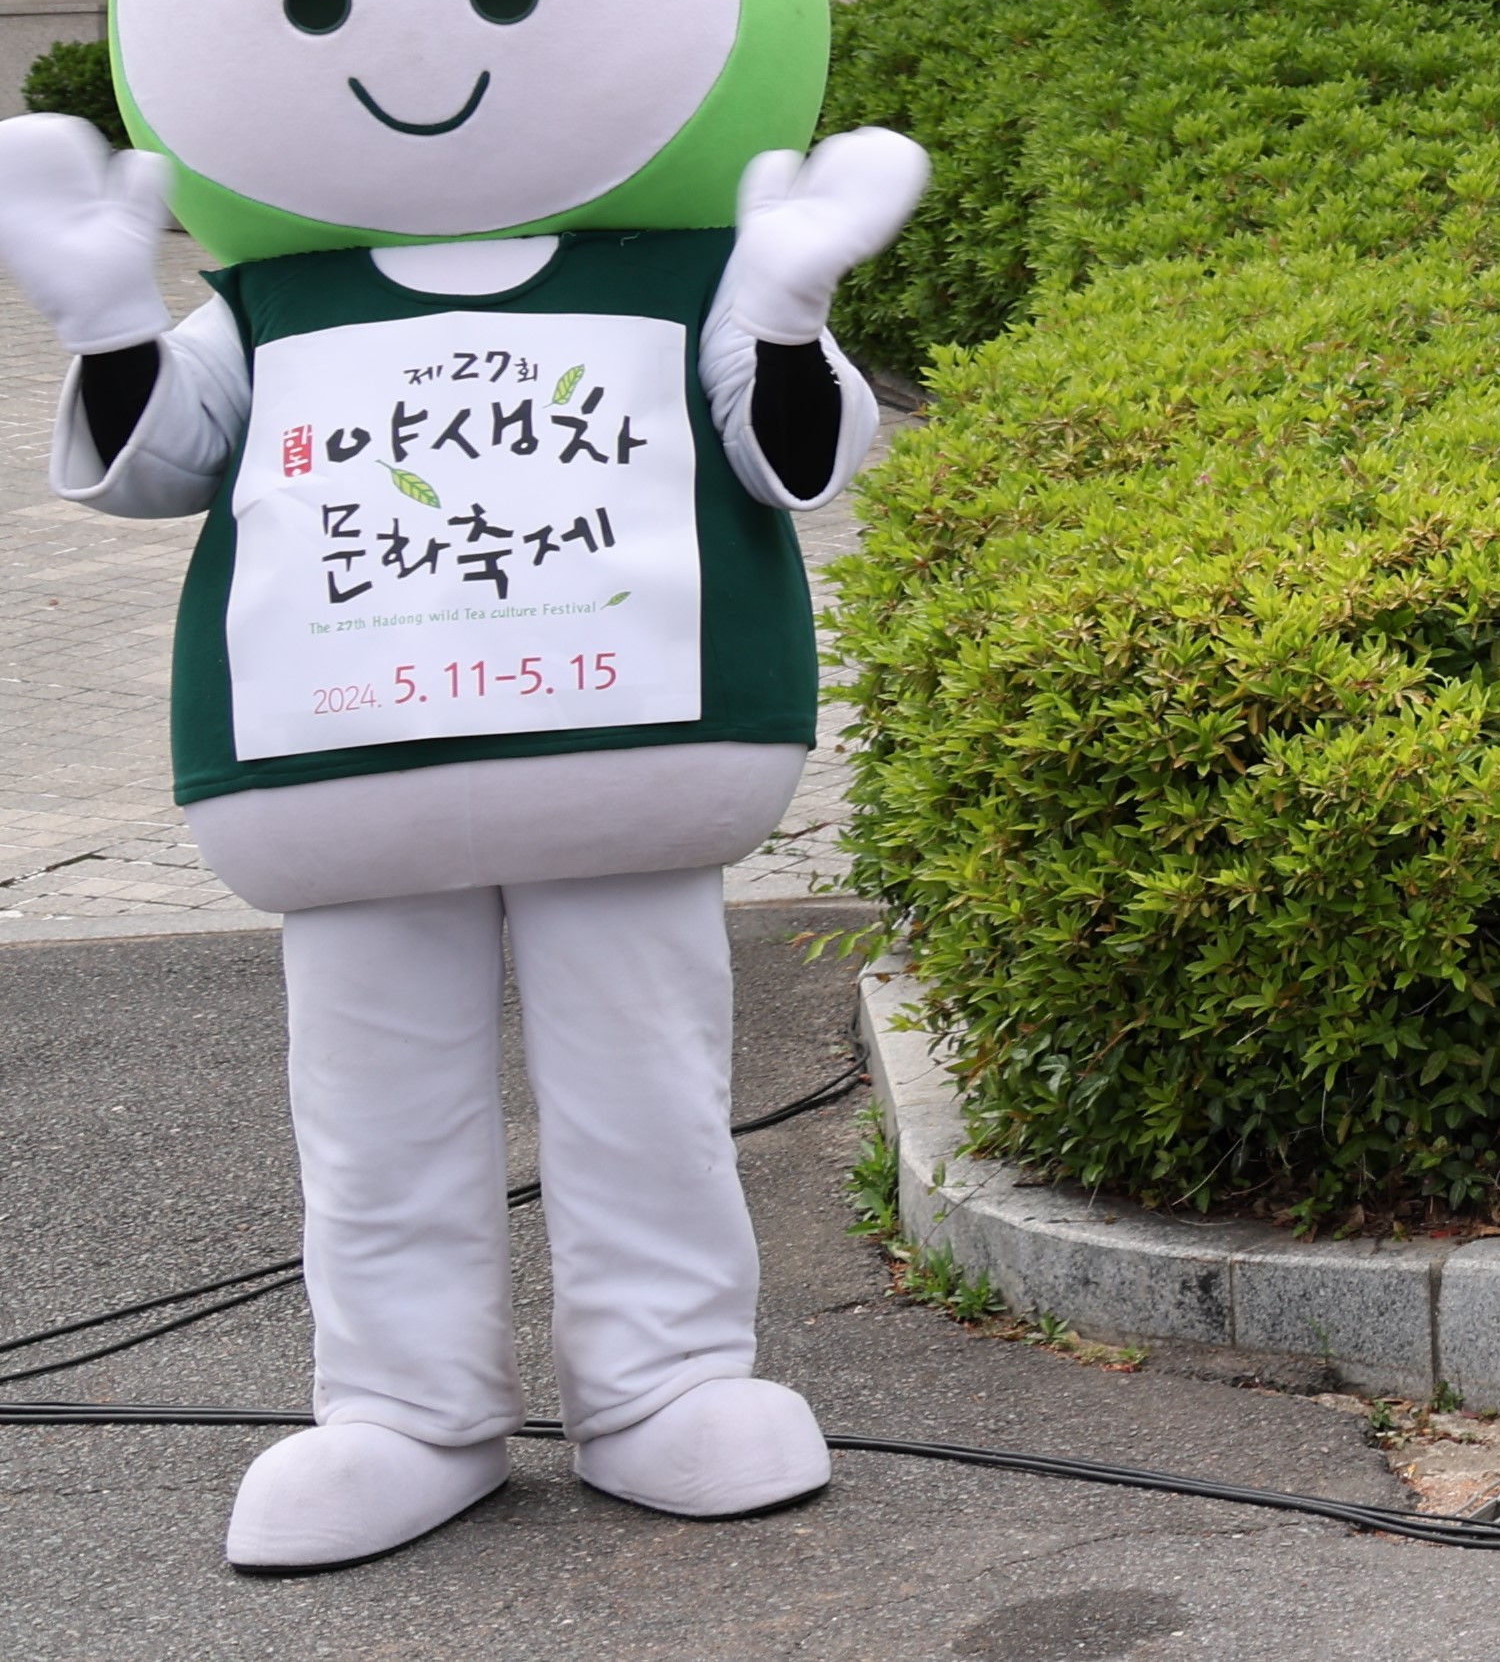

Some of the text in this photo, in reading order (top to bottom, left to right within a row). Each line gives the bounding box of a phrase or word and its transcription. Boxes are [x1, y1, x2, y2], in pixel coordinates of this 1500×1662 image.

[403, 350, 539, 386] 제27회
[325, 386, 647, 464] 야생차
[283, 424, 313, 477] 하동
[321, 502, 616, 604] 문화축제
[309, 601, 597, 635] The 27th Hadong wild Tea culture Festival
[313, 683, 383, 715] 2024.
